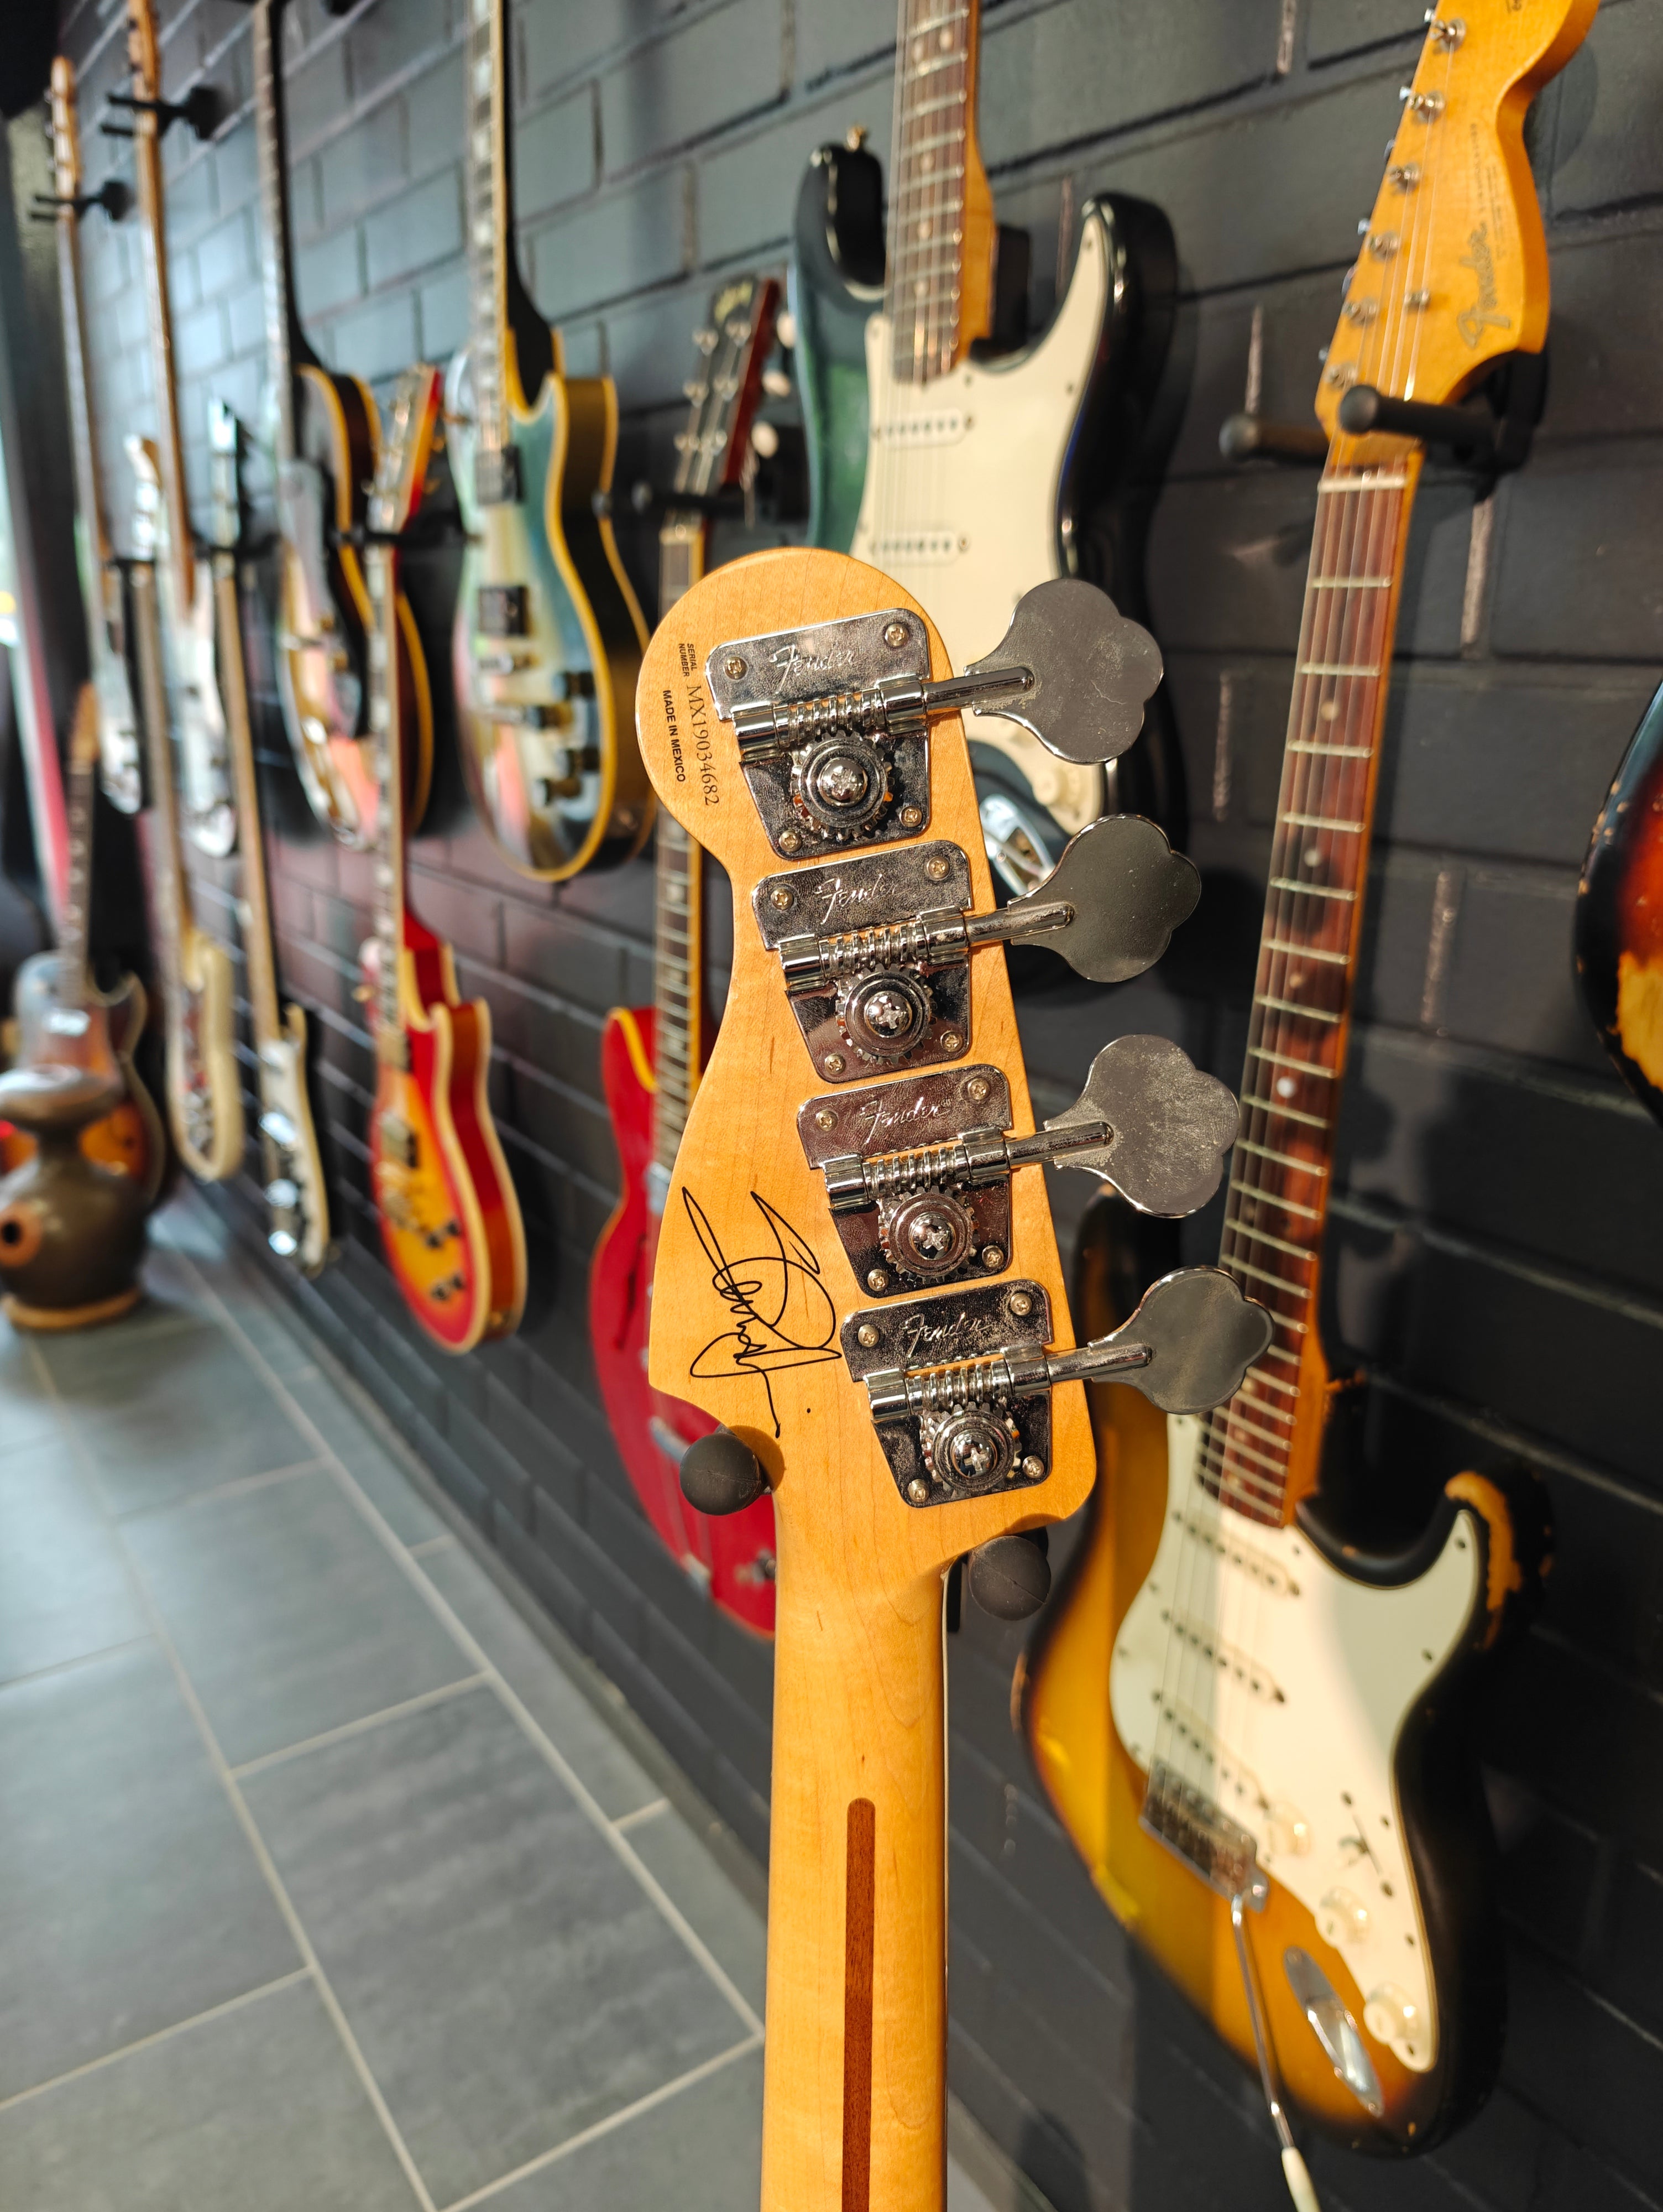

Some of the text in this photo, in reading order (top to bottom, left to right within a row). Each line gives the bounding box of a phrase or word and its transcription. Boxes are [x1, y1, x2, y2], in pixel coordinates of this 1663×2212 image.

[678, 643, 691, 677] NUMBER
[687, 643, 698, 671] SERIAL
[768, 644, 864, 695] Fender
[663, 690, 686, 782] MADE IN MEXICO
[687, 685, 719, 806] MX19034682
[860, 1096, 950, 1145] Fender
[900, 1312, 992, 1358] Fender
